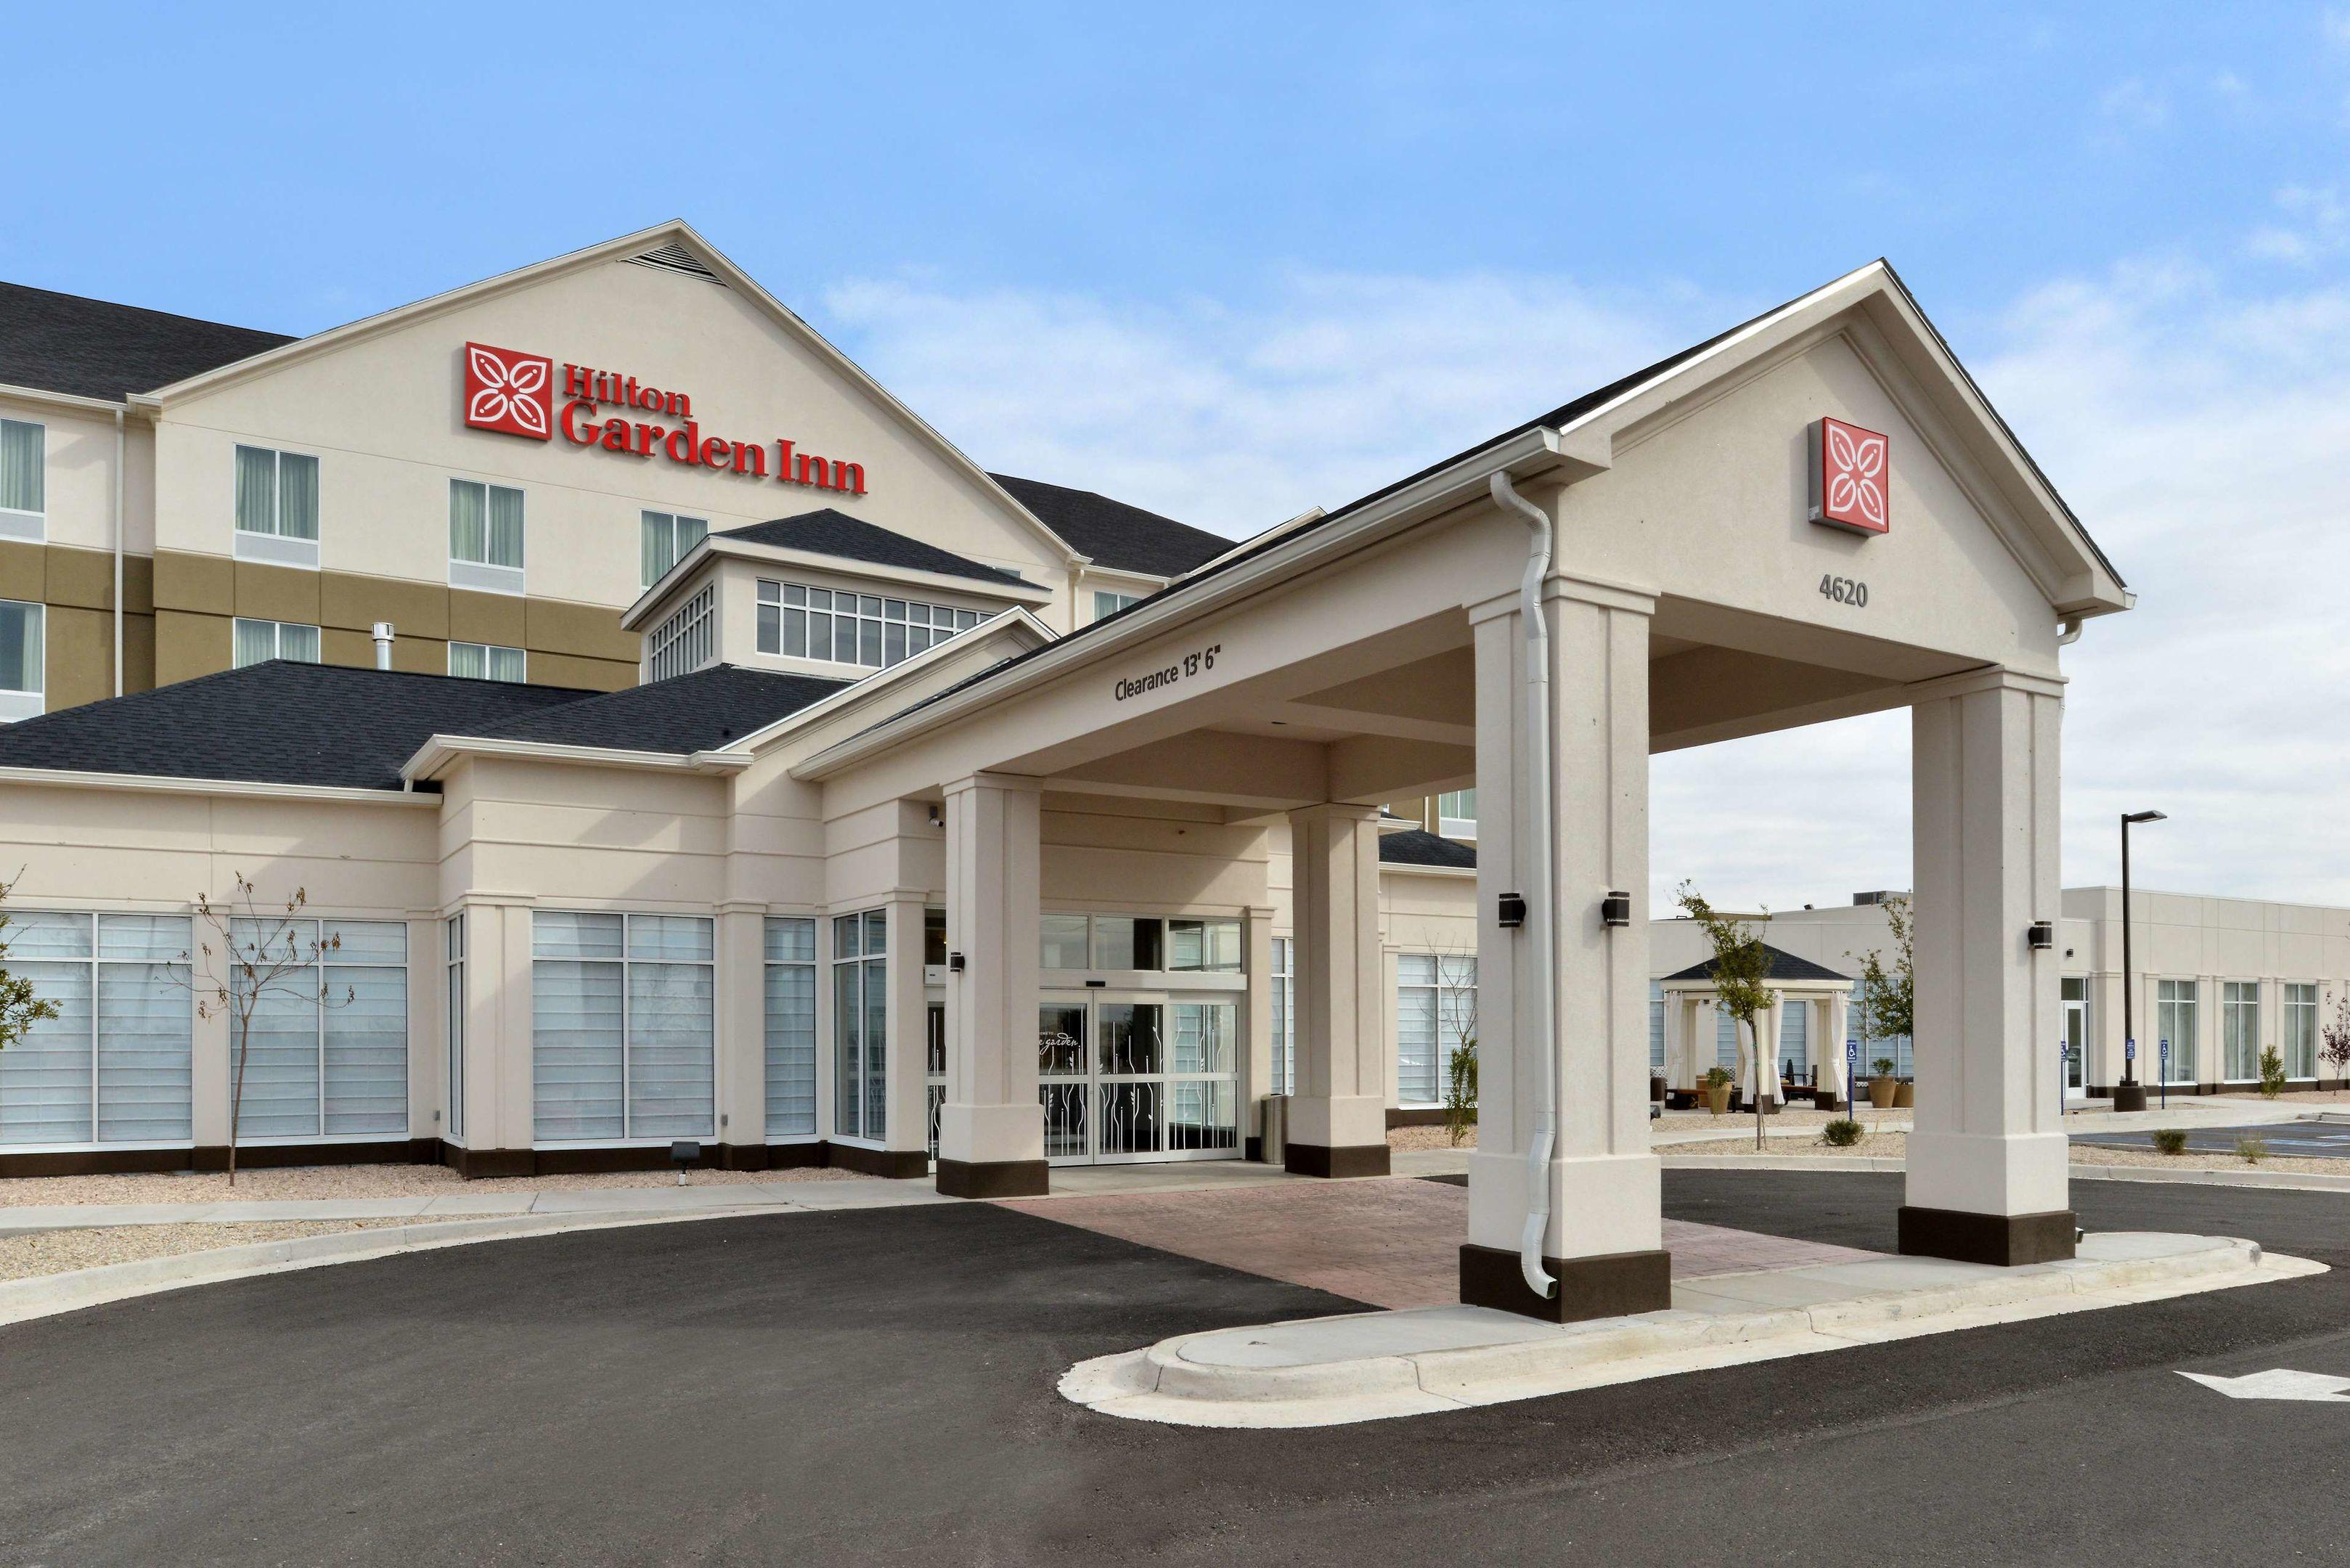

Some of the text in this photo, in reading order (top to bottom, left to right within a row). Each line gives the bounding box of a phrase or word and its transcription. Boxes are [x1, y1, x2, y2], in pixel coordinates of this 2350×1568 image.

[562, 362, 693, 418] Hilton
[560, 399, 869, 495] Garden Inn
[1819, 573, 1869, 608] 4620
[1115, 644, 1221, 701] Clearance 13' 6"
